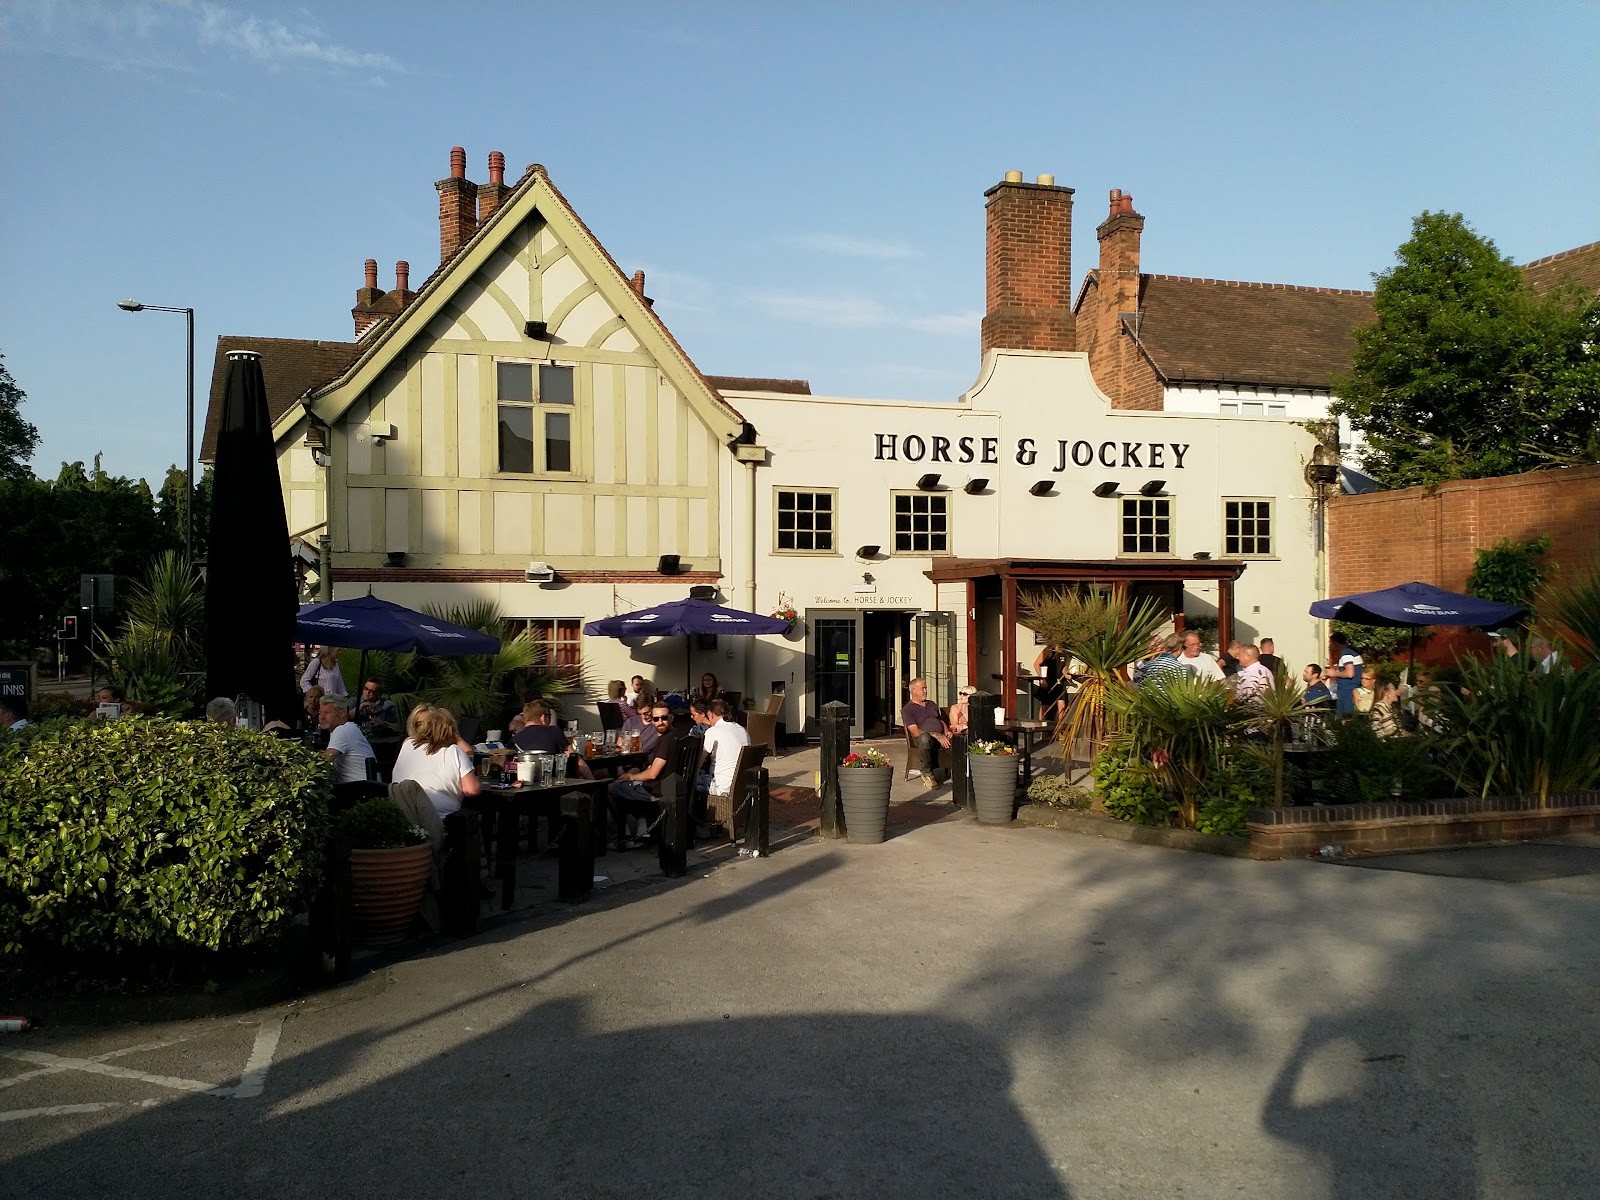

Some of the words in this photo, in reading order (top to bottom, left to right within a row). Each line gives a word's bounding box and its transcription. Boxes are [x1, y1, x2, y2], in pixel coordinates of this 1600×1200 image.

[873, 432, 998, 464] HORSE
[1015, 437, 1038, 466] &
[1052, 439, 1191, 472] JOCKEY
[854, 596, 877, 604] HORSE
[886, 596, 913, 604] JOCKEY
[1403, 607, 1436, 615] BOOM
[3, 684, 25, 696] INNS
[500, 773, 511, 782] 59
